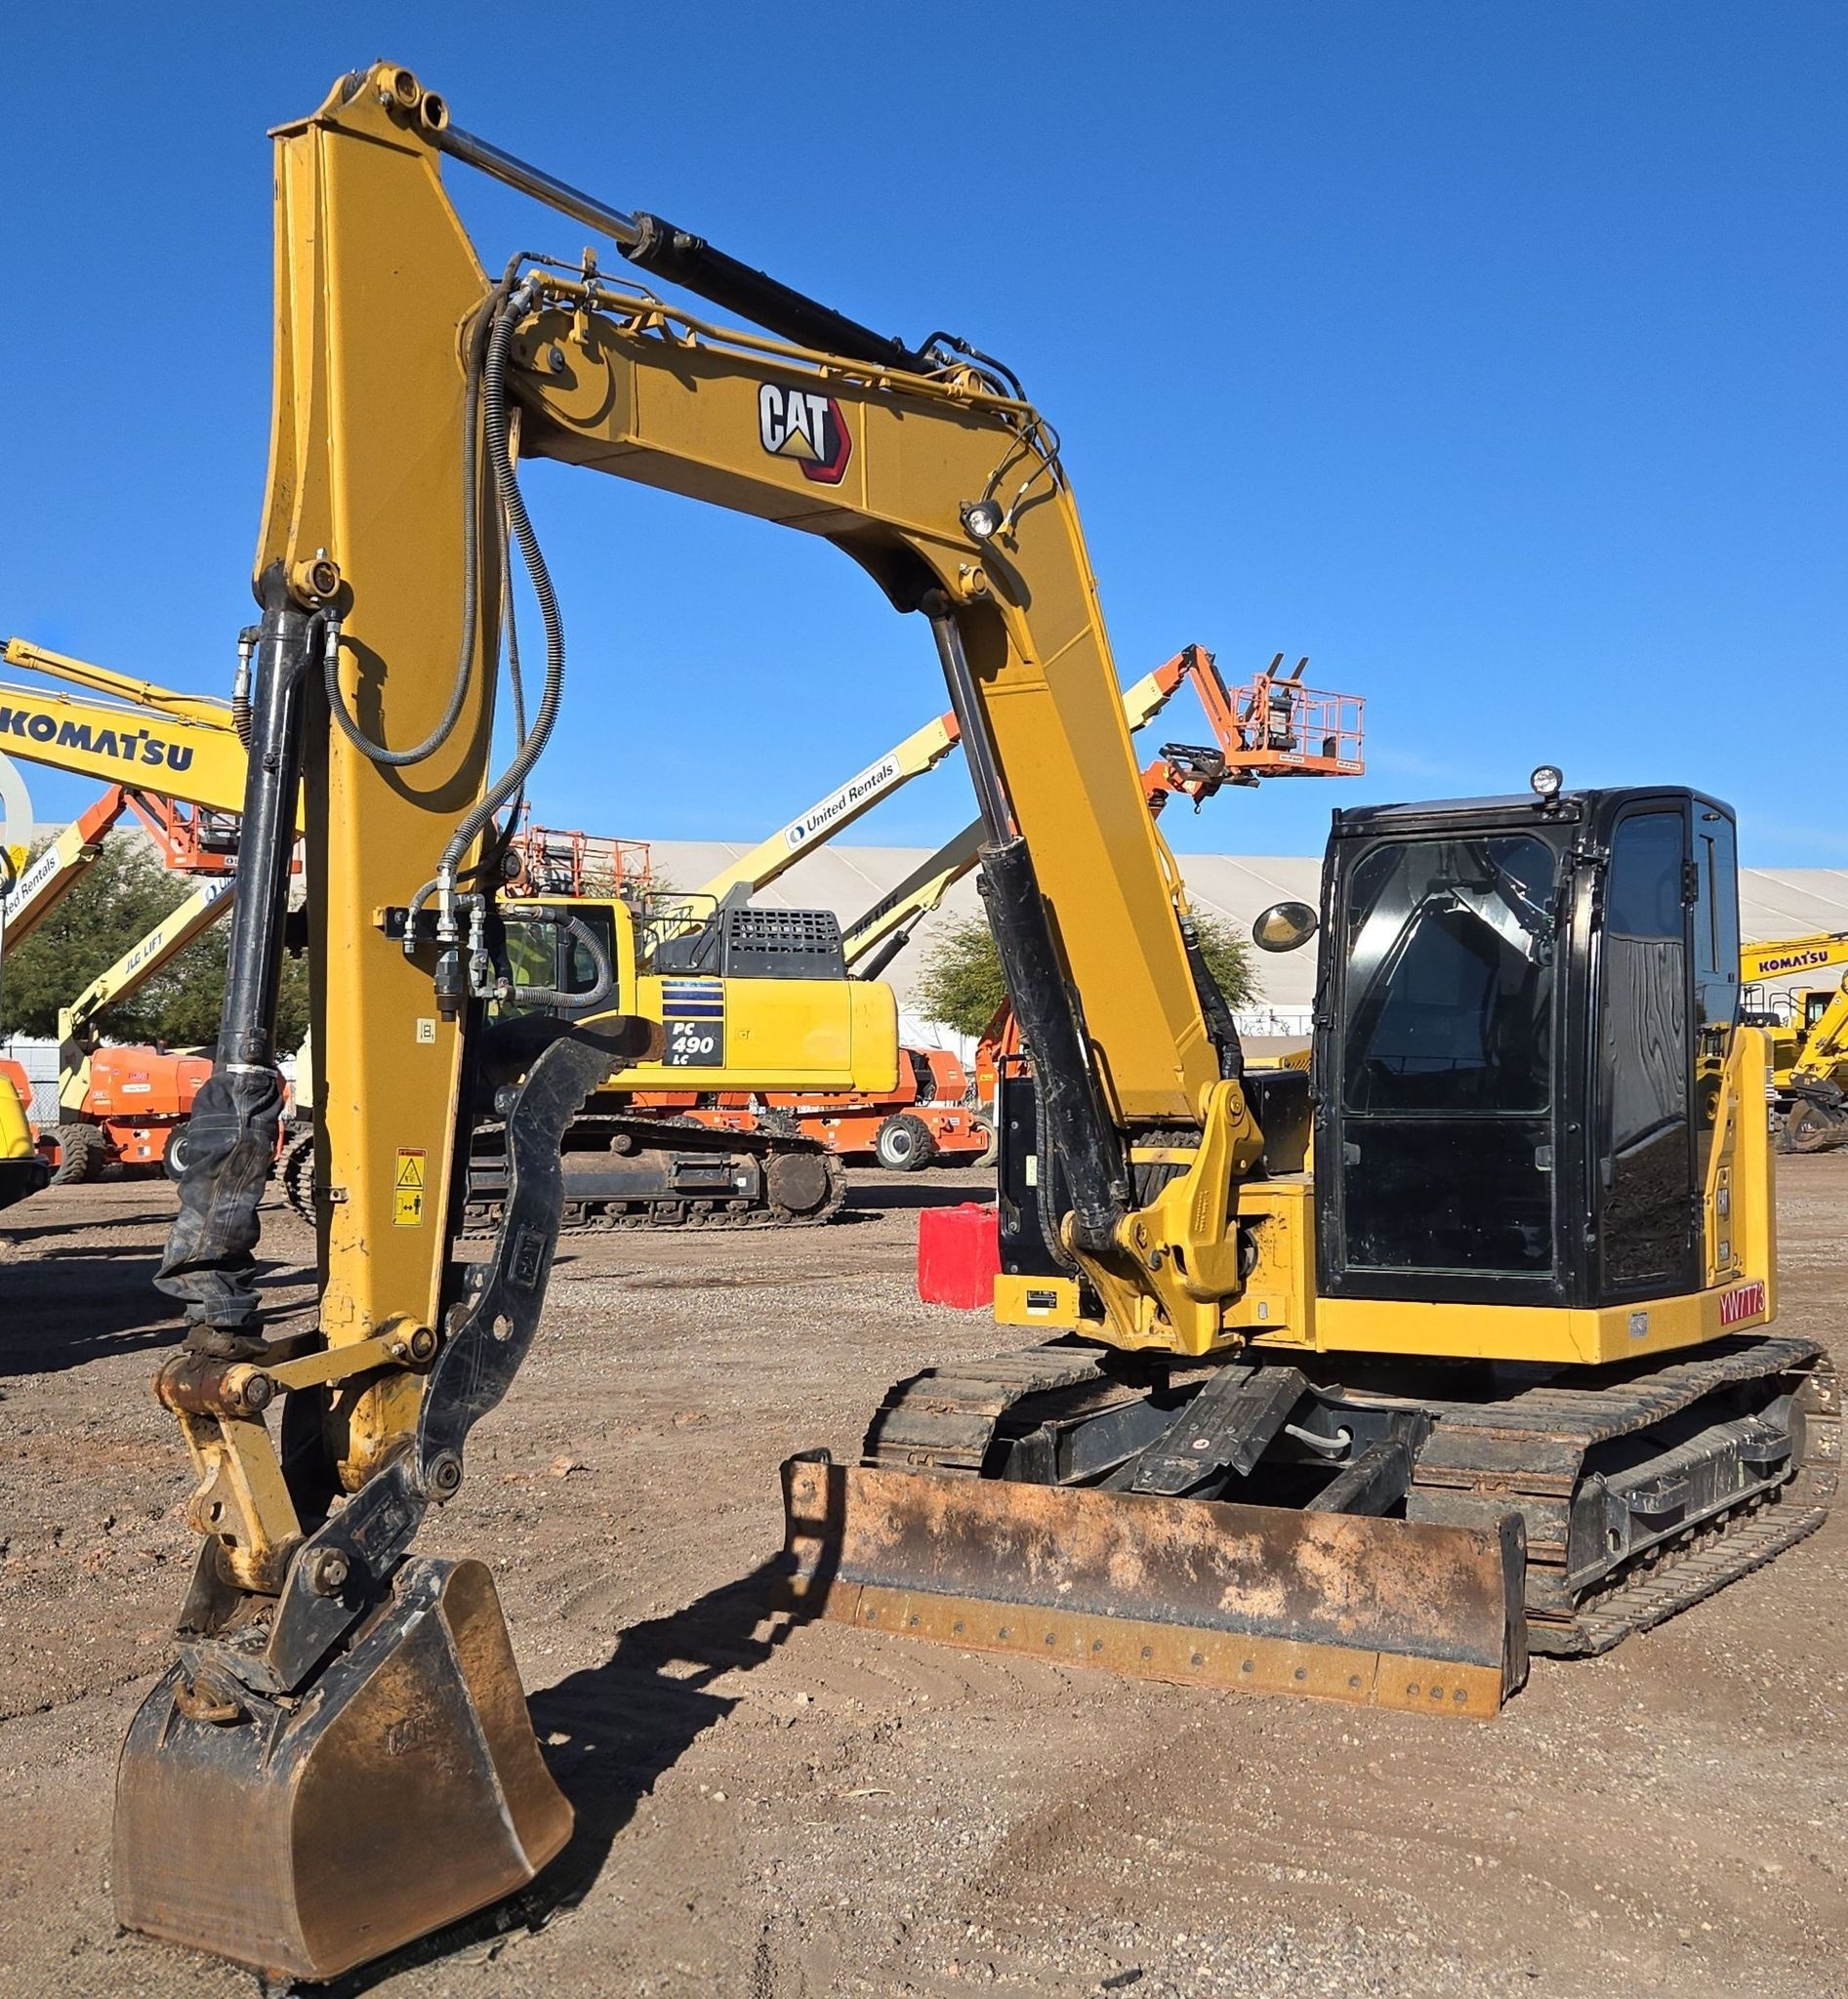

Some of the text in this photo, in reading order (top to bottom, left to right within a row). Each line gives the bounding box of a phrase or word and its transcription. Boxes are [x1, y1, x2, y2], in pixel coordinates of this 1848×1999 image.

[760, 384, 828, 462] CAT
[0, 707, 193, 771] KOMATSU
[806, 763, 894, 831] United Rentals
[21, 857, 56, 899] Rentals
[126, 931, 163, 974] JLG LIFT
[1759, 951, 1828, 972] KOMATSU
[672, 1022, 695, 1036] PC
[672, 1037, 715, 1054] 490
[672, 1054, 689, 1065] LC
